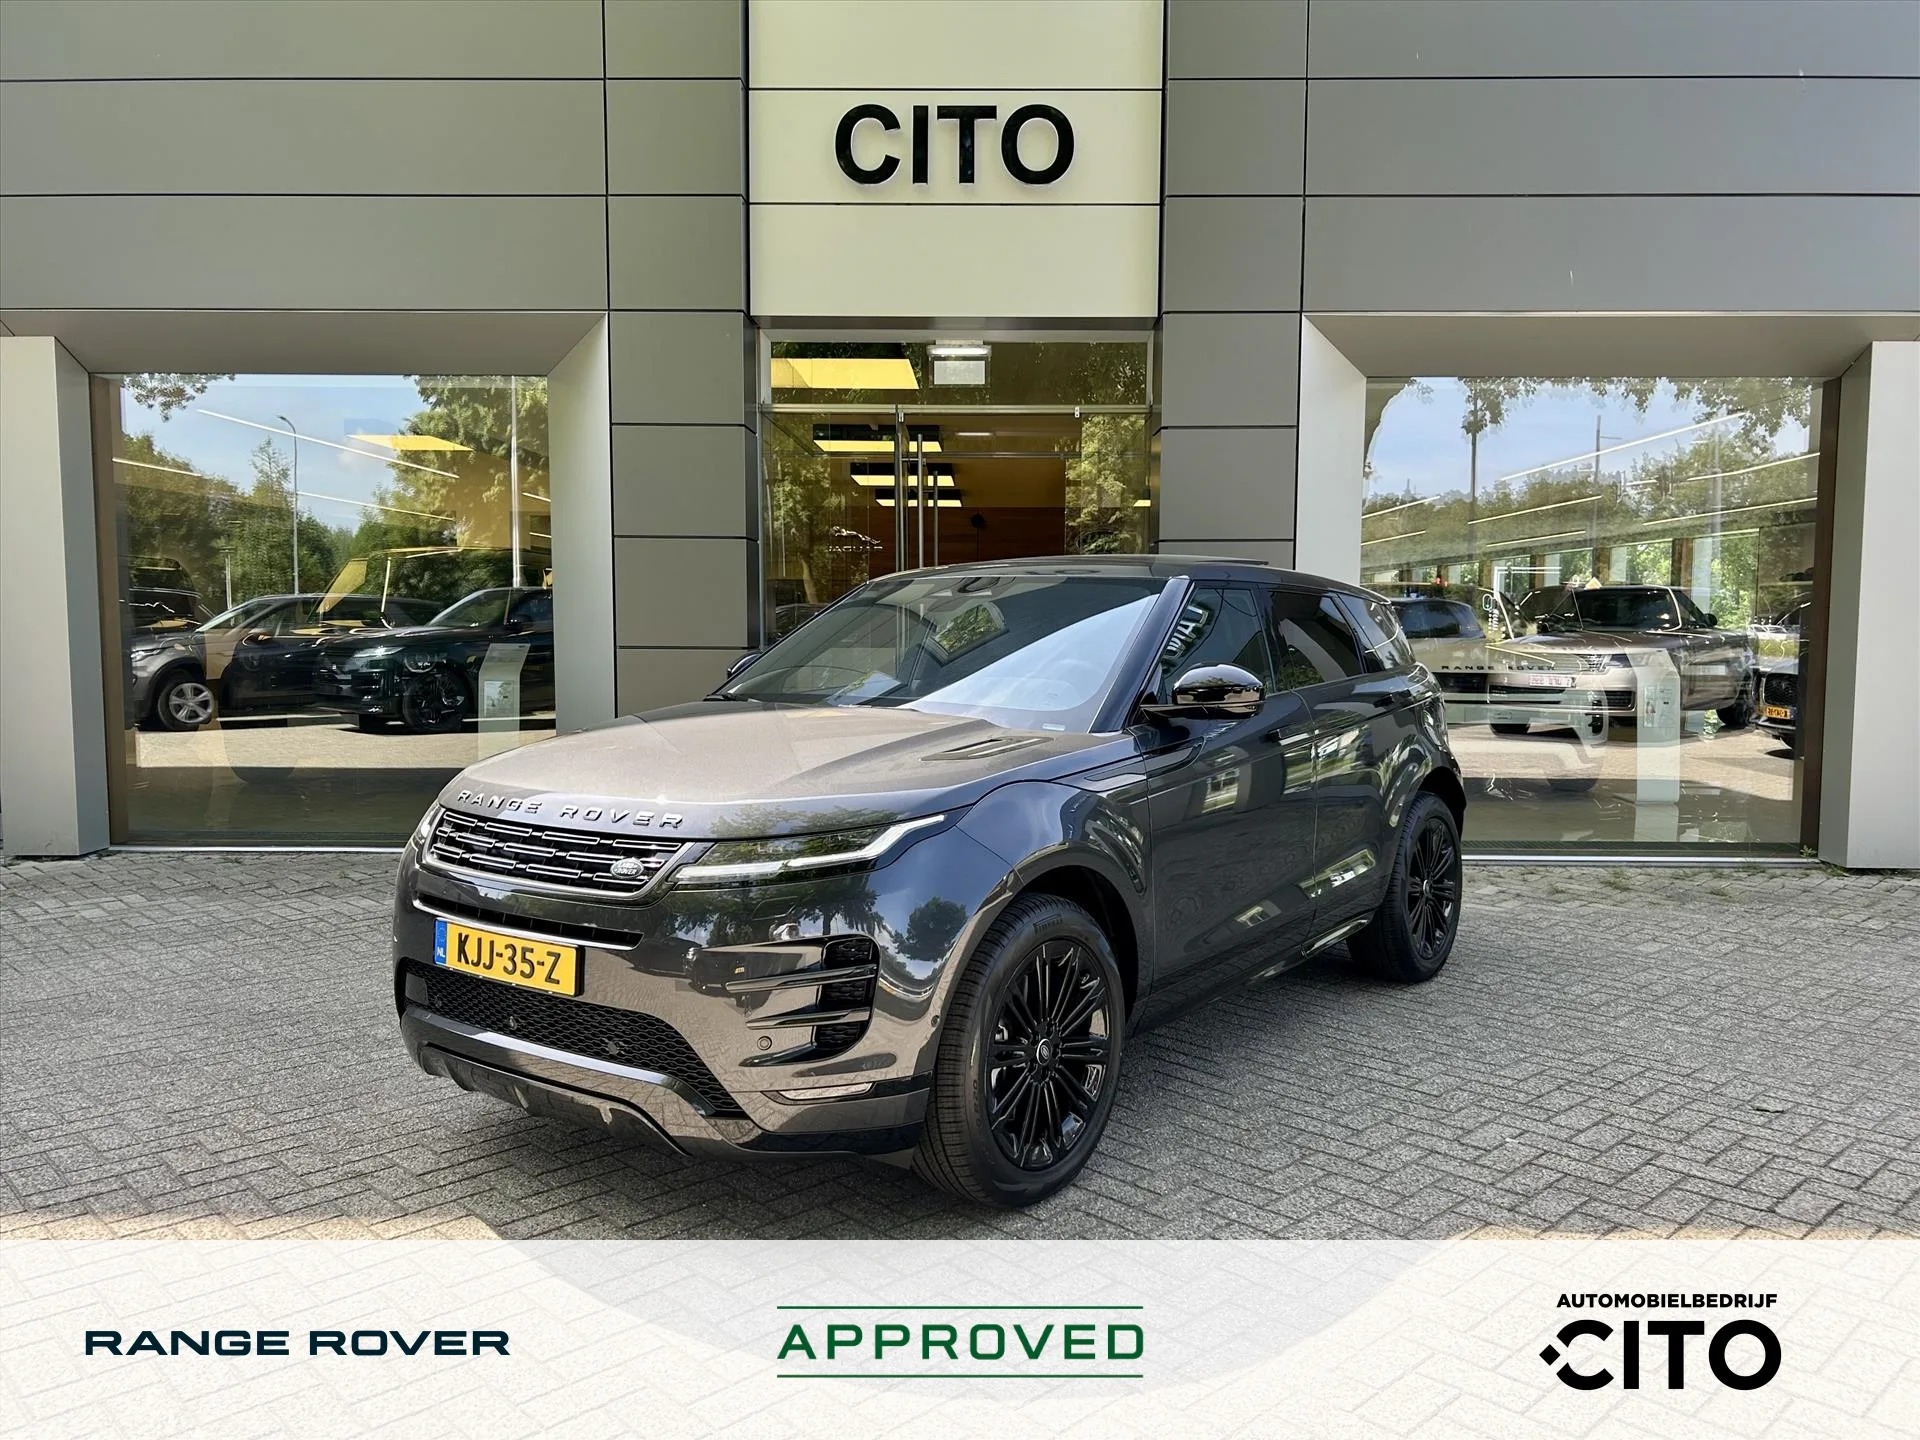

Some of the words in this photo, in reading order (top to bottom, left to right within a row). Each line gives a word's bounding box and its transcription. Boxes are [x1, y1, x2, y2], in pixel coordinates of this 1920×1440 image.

[835, 104, 1075, 184] CITO
[457, 790, 541, 814] RANGE
[559, 804, 683, 829] ROVER
[436, 946, 446, 957] NL
[457, 932, 561, 985] KJJ-35-Z
